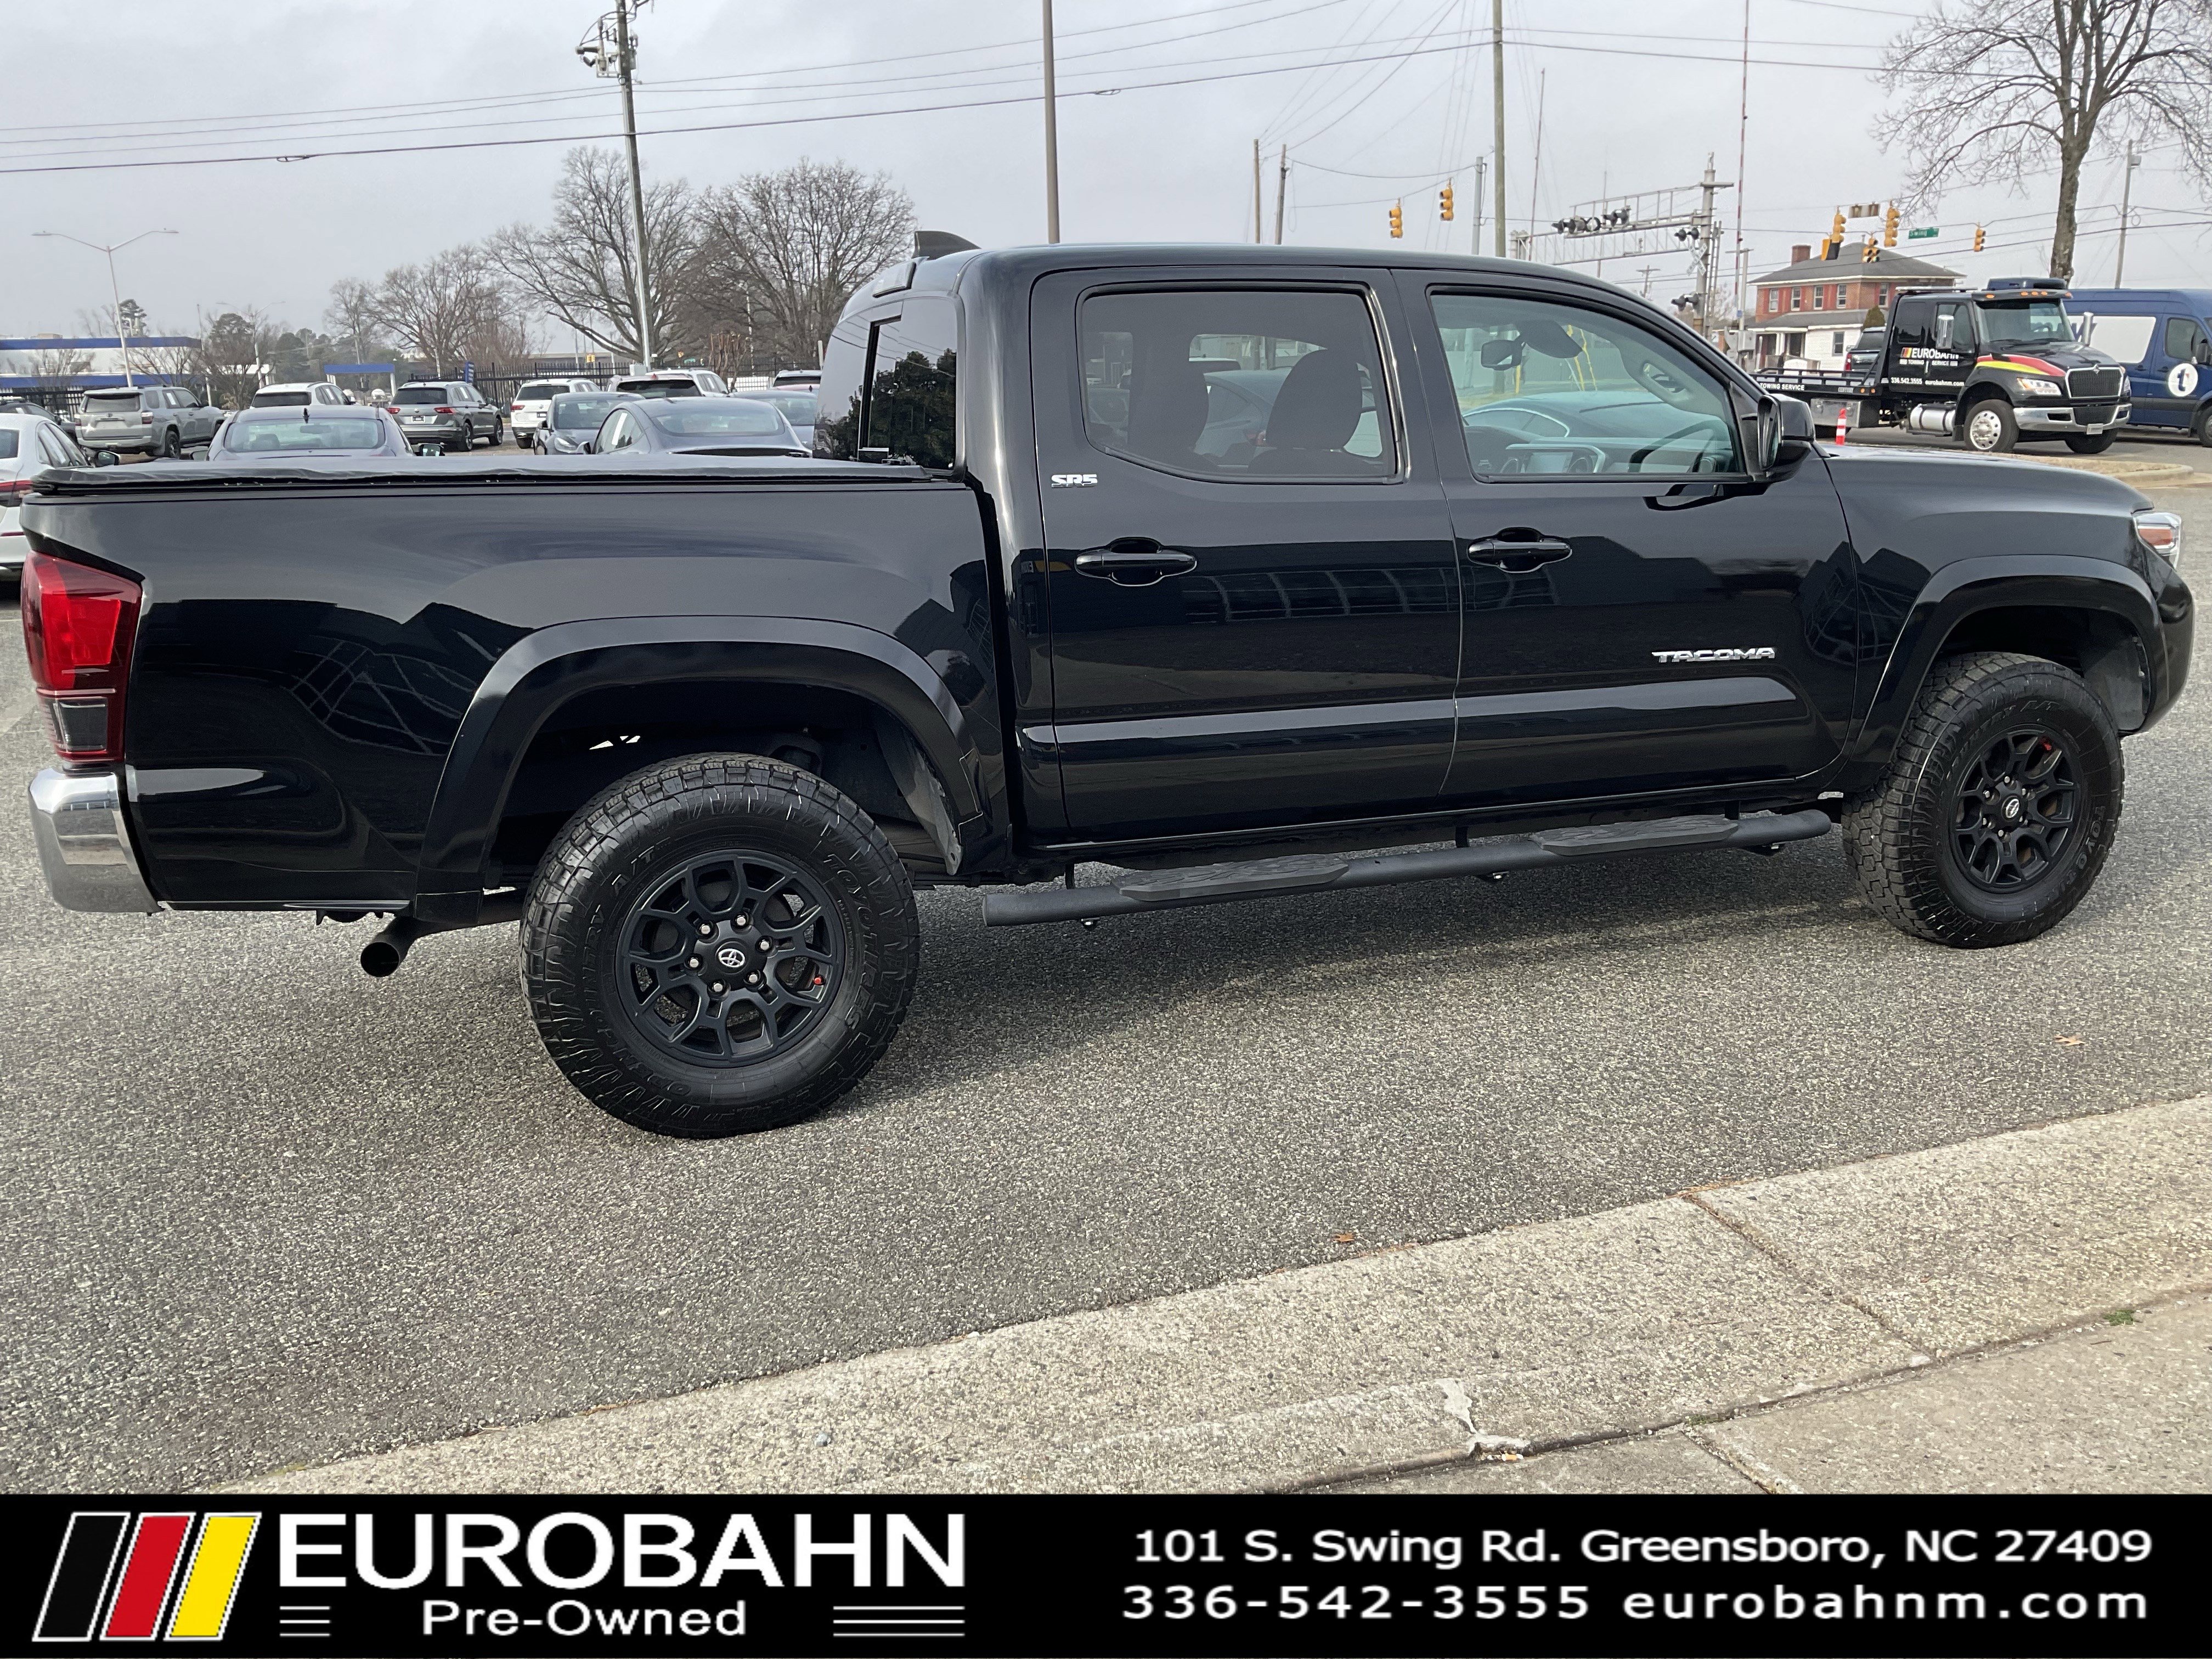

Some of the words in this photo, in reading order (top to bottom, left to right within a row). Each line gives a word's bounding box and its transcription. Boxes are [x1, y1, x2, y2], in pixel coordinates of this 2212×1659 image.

[1052, 474, 1098, 488] SR5
[1651, 647, 1775, 663] TACOMA
[823, 854, 876, 928] TOYO
[845, 932, 880, 1030] TIRES
